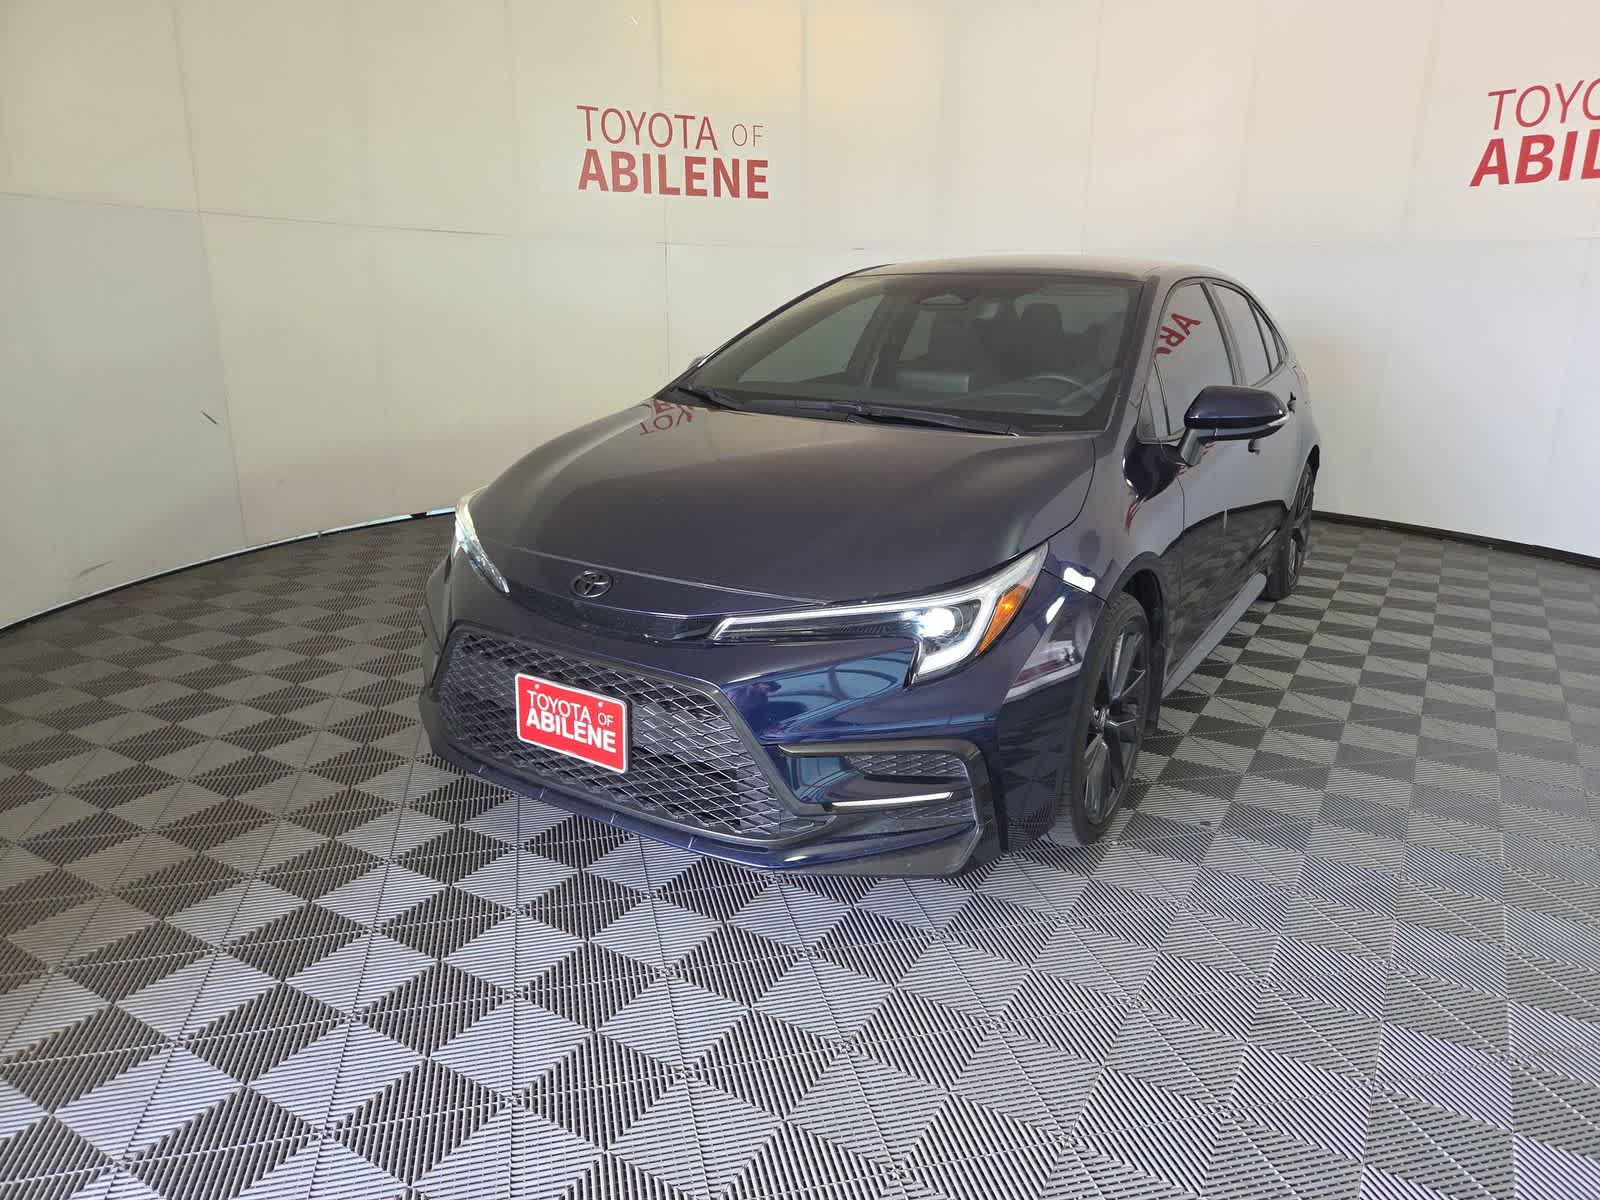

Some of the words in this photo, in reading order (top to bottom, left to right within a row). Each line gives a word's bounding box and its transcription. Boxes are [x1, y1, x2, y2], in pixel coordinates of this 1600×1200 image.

[577, 105, 719, 151] TOYOTA
[732, 124, 764, 147] OF
[578, 149, 769, 199] ABILENE
[526, 707, 616, 753] ABILENE
[527, 690, 592, 724] TOYOTA
[598, 712, 614, 726] OF
